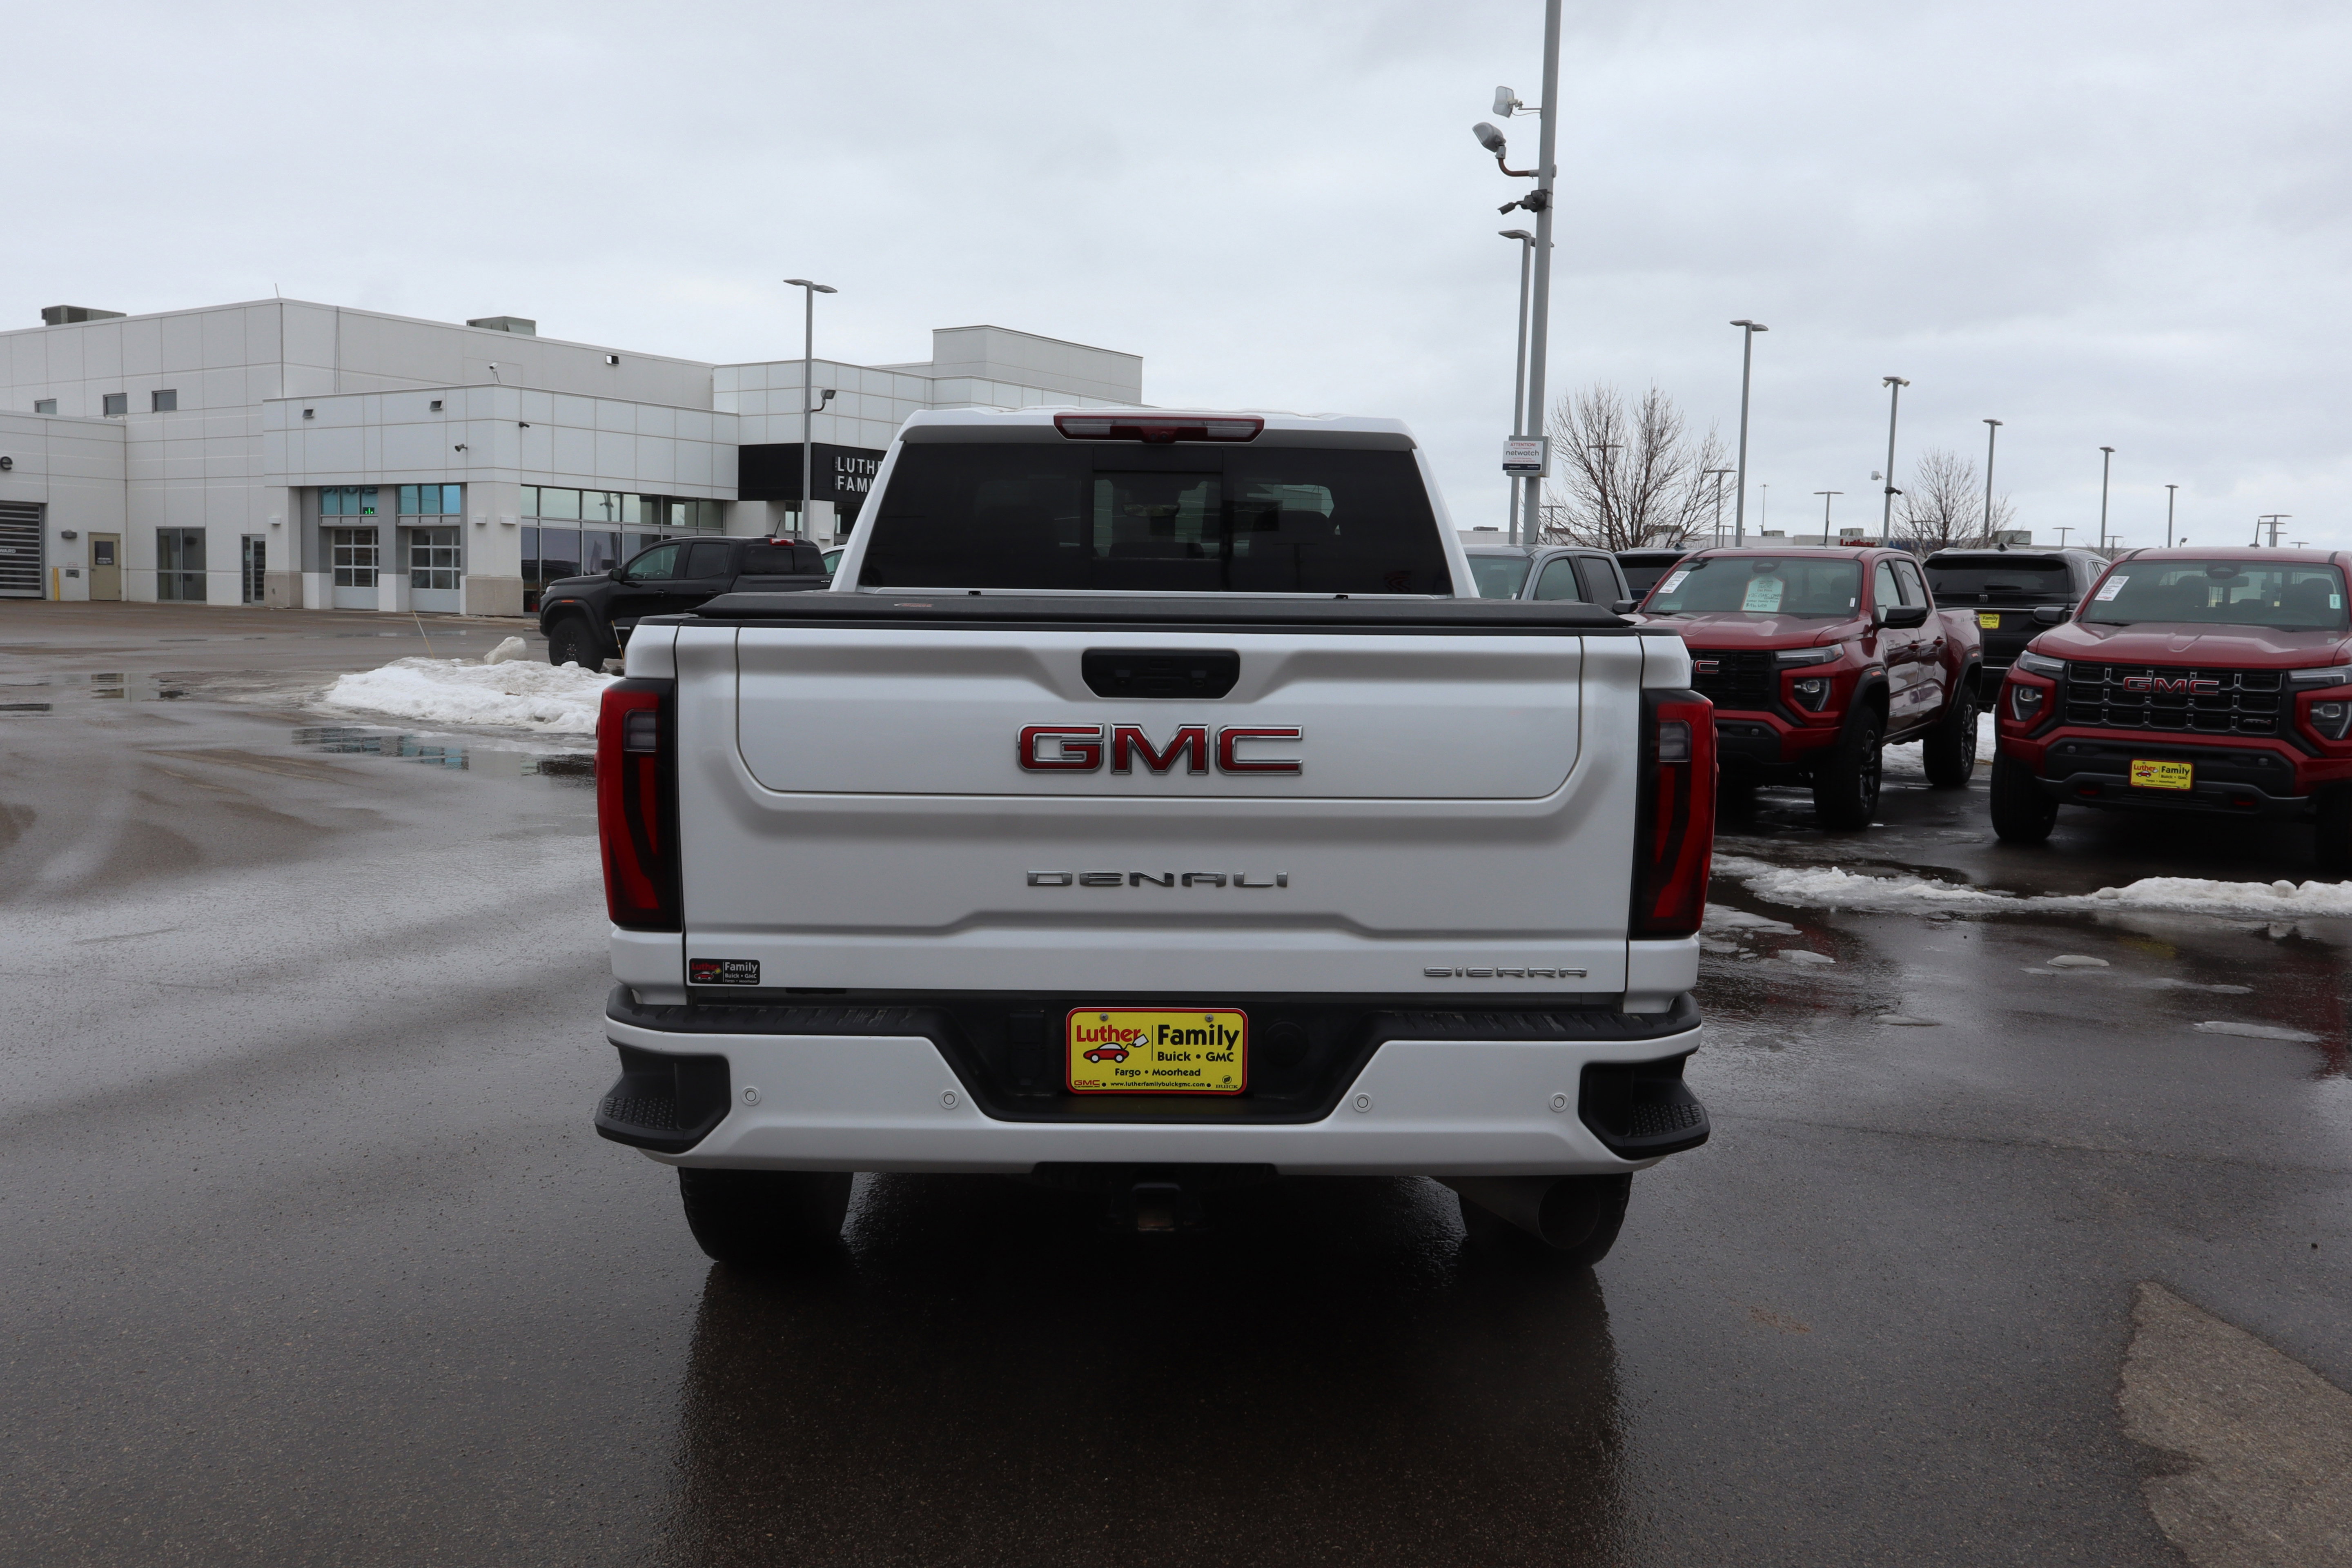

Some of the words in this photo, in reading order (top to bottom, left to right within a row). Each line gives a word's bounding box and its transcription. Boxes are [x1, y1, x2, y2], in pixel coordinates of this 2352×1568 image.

[1692, 660, 1719, 674] C
[2123, 677, 2219, 695] GMC
[1016, 723, 1303, 775] GMC
[2161, 766, 2190, 776] Family
[1027, 870, 1288, 887] DENALI
[692, 962, 720, 971] Luther
[725, 962, 758, 973] Family
[1424, 967, 1587, 978] SIERRA
[1076, 1025, 1141, 1042] Luther
[1158, 1024, 1240, 1051] Family
[1157, 1051, 1191, 1062] Buick
[1205, 1052, 1234, 1062] GMC
[1115, 1068, 1141, 1078] Fargo
[1152, 1068, 1200, 1076] Moorhead
